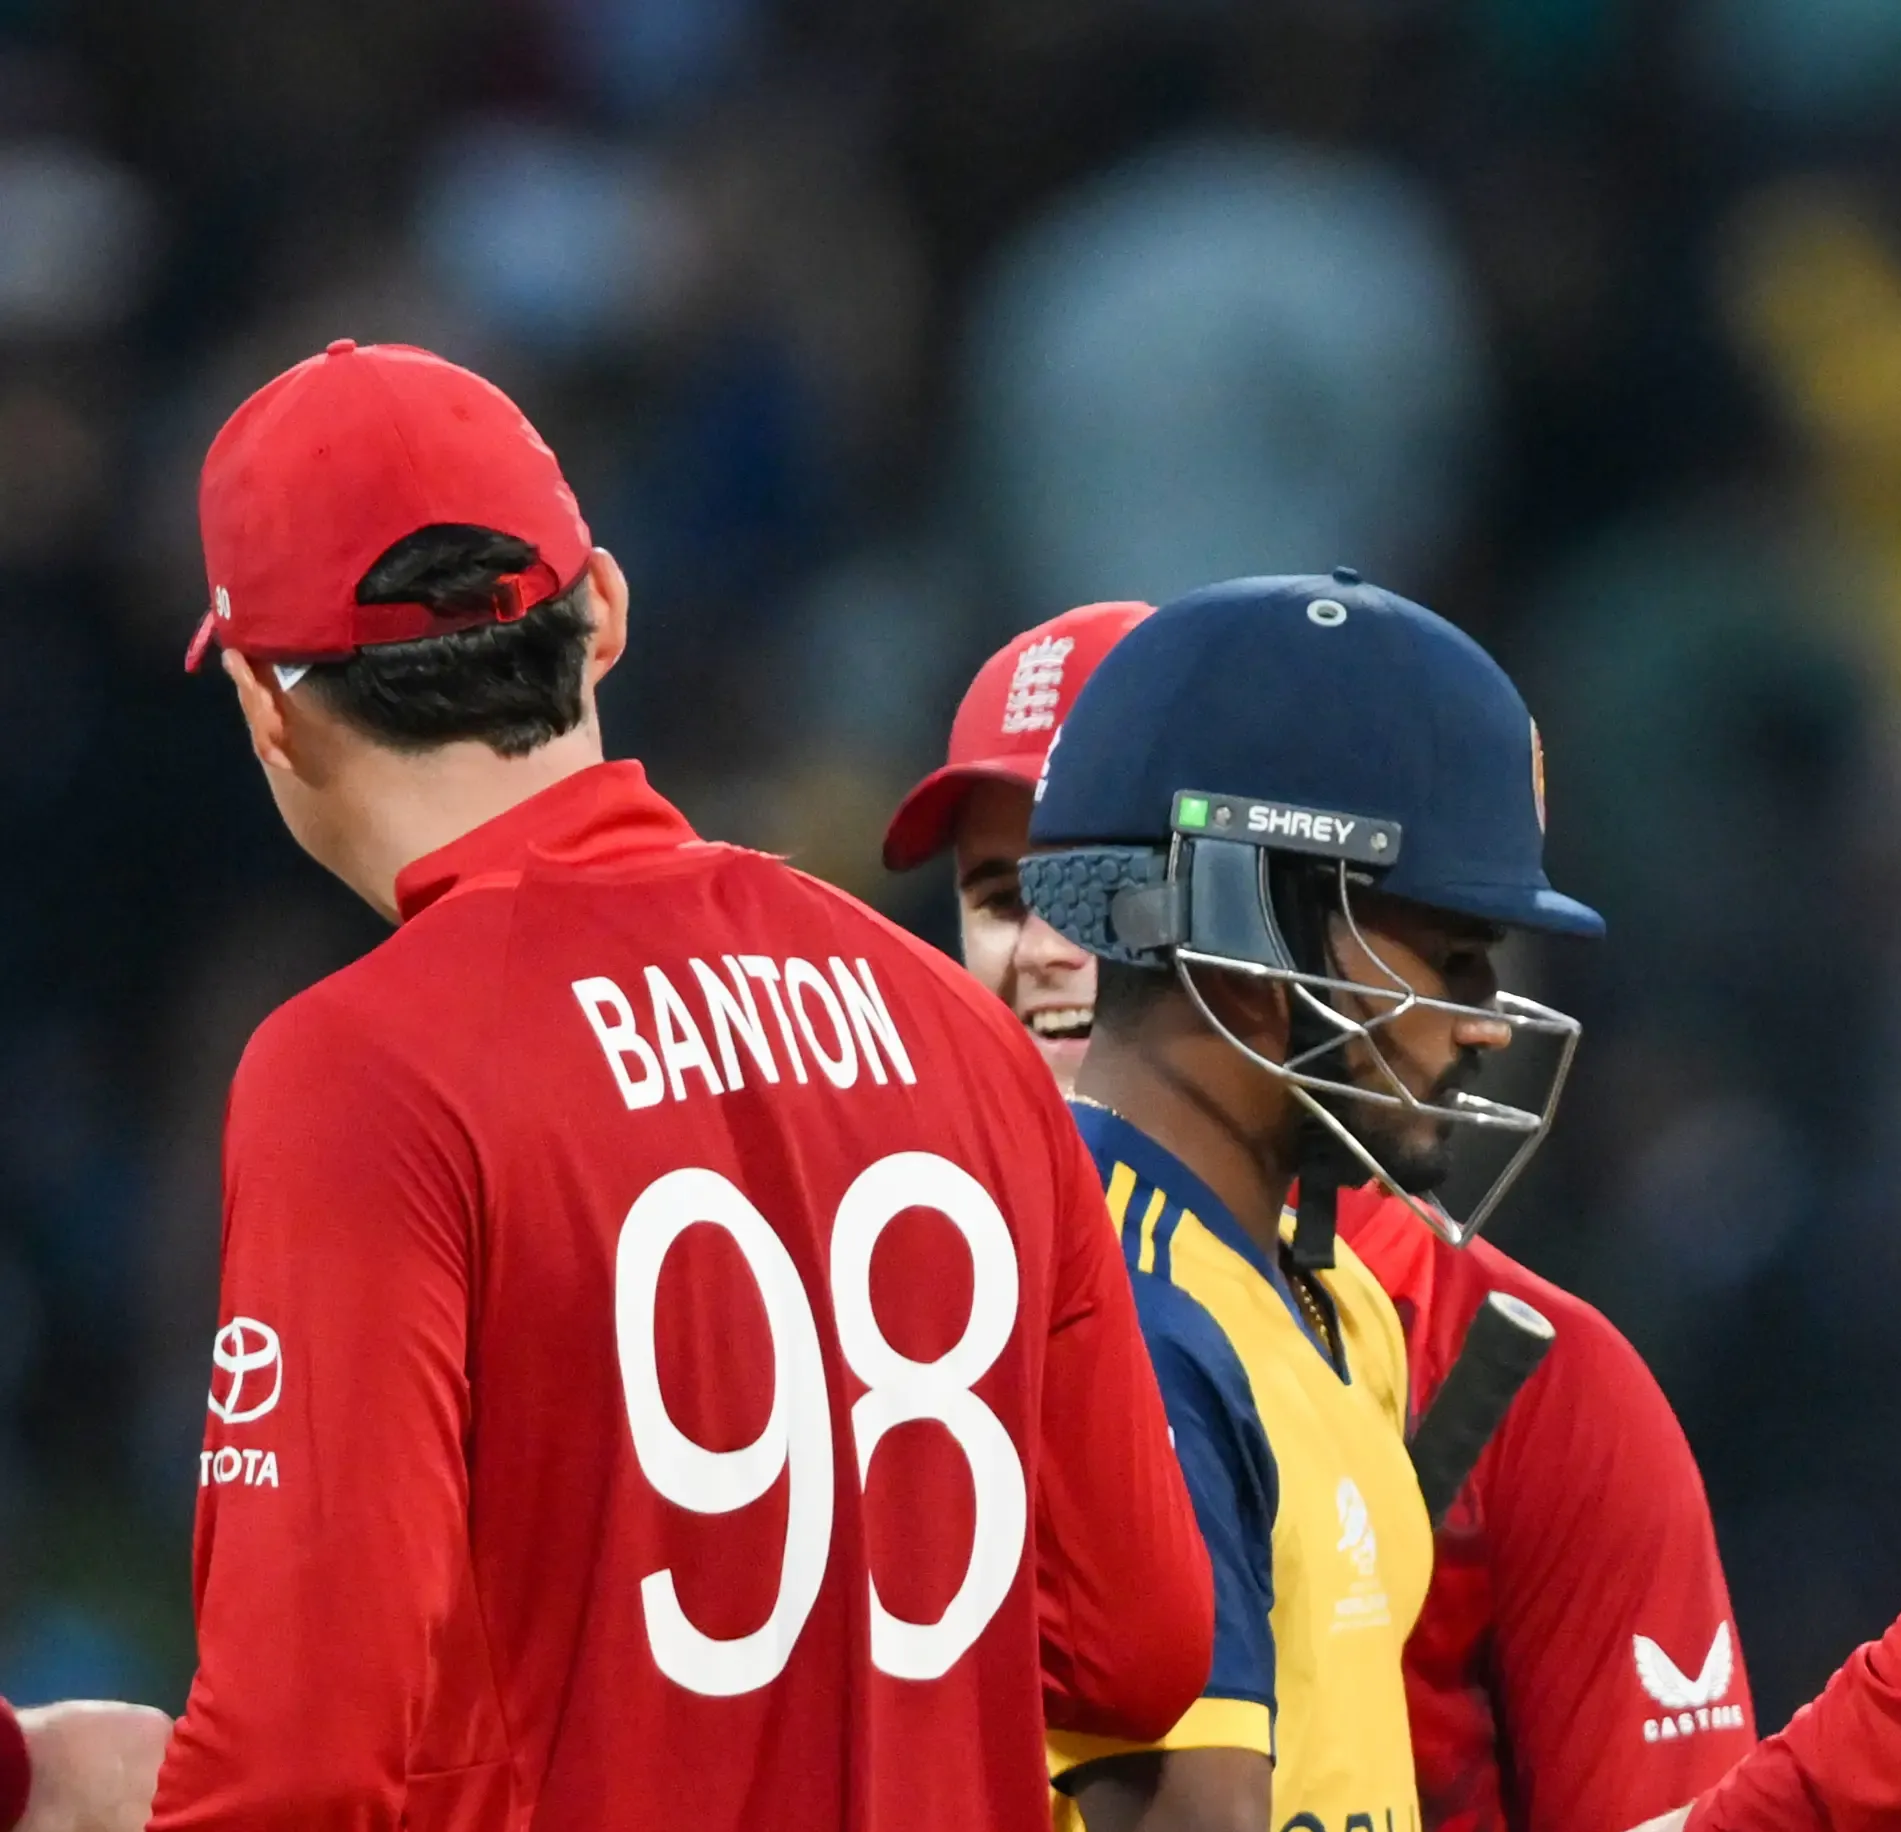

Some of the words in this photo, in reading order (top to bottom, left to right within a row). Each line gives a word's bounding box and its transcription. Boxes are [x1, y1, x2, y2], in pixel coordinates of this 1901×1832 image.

[1248, 805, 1355, 845] SHREY
[571, 954, 917, 1111] BANTON
[615, 1151, 1027, 1697] 98
